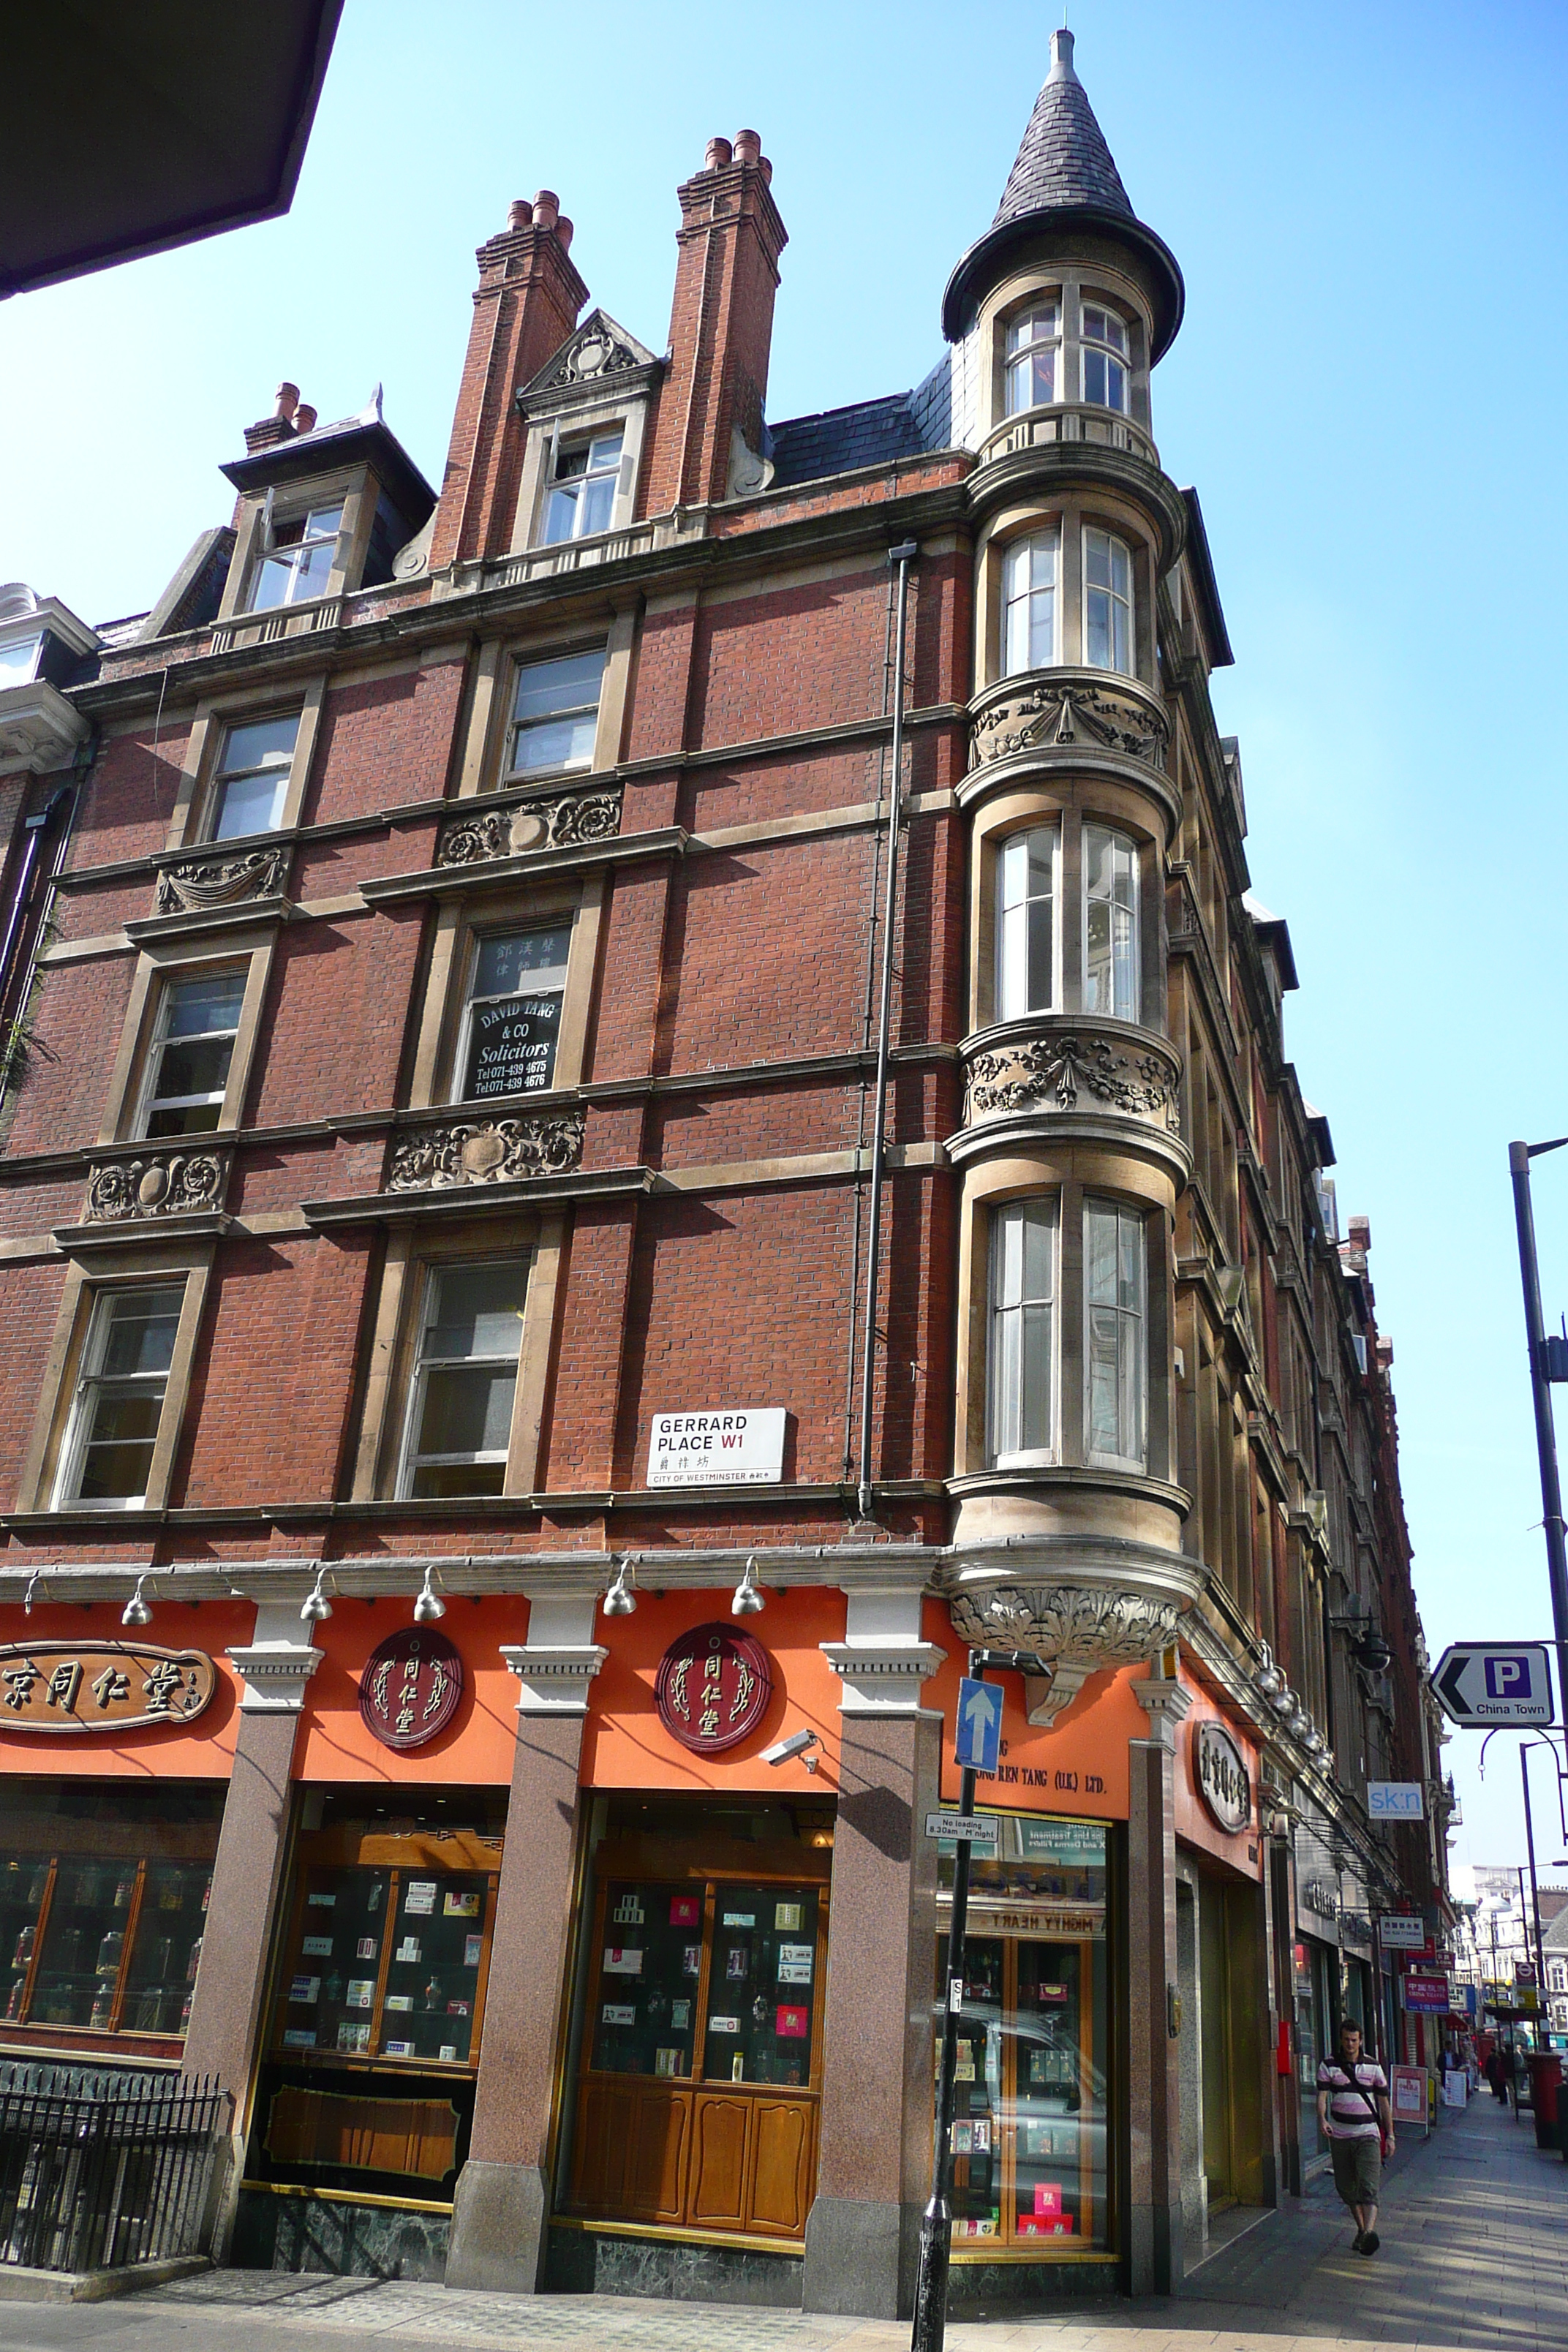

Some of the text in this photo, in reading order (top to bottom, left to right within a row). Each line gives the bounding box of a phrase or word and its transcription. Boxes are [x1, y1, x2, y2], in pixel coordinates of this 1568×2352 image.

[480, 1001, 556, 1029] DAVID TANG
[502, 1023, 529, 1039] & CO
[479, 1041, 550, 1064] Solicitors
[525, 1060, 547, 1074] 4675
[524, 1074, 546, 1088] 4676
[660, 1416, 747, 1433] GERRARD
[658, 1434, 743, 1452] PLACE W1
[653, 1474, 671, 1483] CITY
[674, 1474, 685, 1482] OF
[687, 1472, 746, 1482] WESTMINSTER
[1, 1657, 181, 1714] 京同仁堂
[396, 1656, 420, 1734] 同仁堂
[699, 1654, 723, 1737] 同仁堂
[1476, 1703, 1545, 1714] China Town
[976, 1769, 995, 1782] ONG
[998, 1765, 1019, 1784] REN
[1022, 1768, 1048, 1787] TANG
[1085, 1775, 1107, 1795] LTD.
[930, 1825, 958, 1835] 8.30am
[955, 1820, 982, 1830] loading
[954, 1982, 961, 1994] S
[955, 1999, 960, 2010] 1
